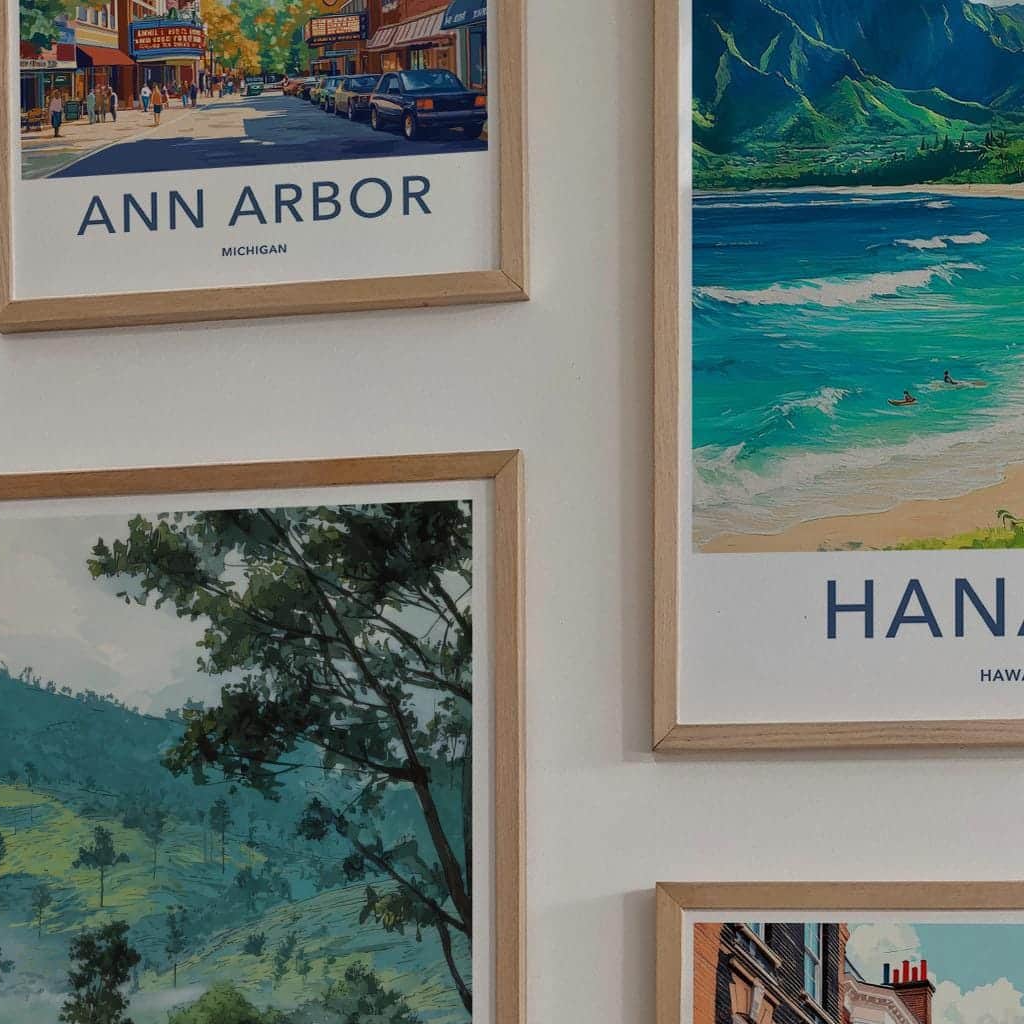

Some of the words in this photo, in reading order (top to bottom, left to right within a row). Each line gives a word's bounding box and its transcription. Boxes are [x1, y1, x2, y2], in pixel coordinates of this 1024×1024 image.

[77, 188, 204, 236] ANN
[228, 175, 432, 227] ARBOR
[222, 243, 287, 257] MICHIGAN
[827, 577, 1024, 639] HAN
[980, 669, 1024, 682] HAW
